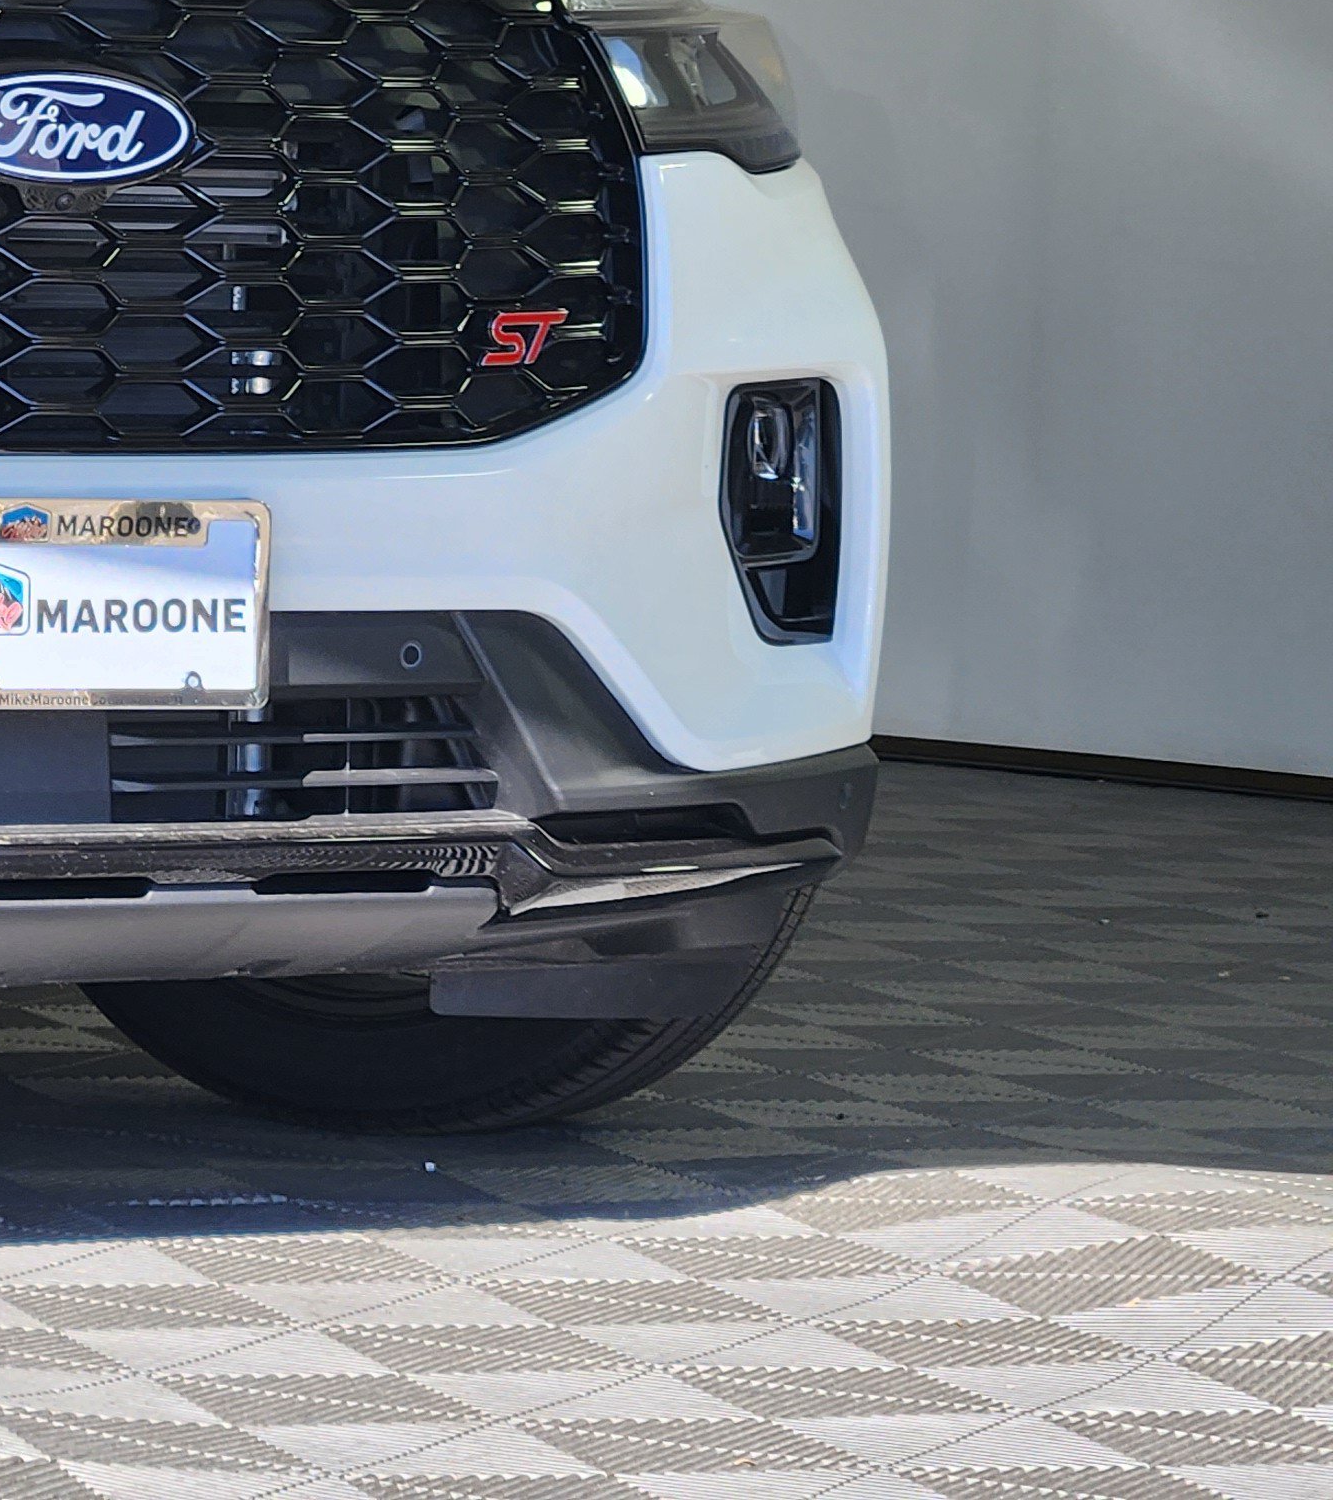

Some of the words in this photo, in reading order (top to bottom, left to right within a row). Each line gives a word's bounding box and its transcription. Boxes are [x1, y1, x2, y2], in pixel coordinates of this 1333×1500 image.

[480, 308, 569, 367] ST
[56, 514, 190, 538] MAROONE
[36, 598, 247, 634] MAROONE
